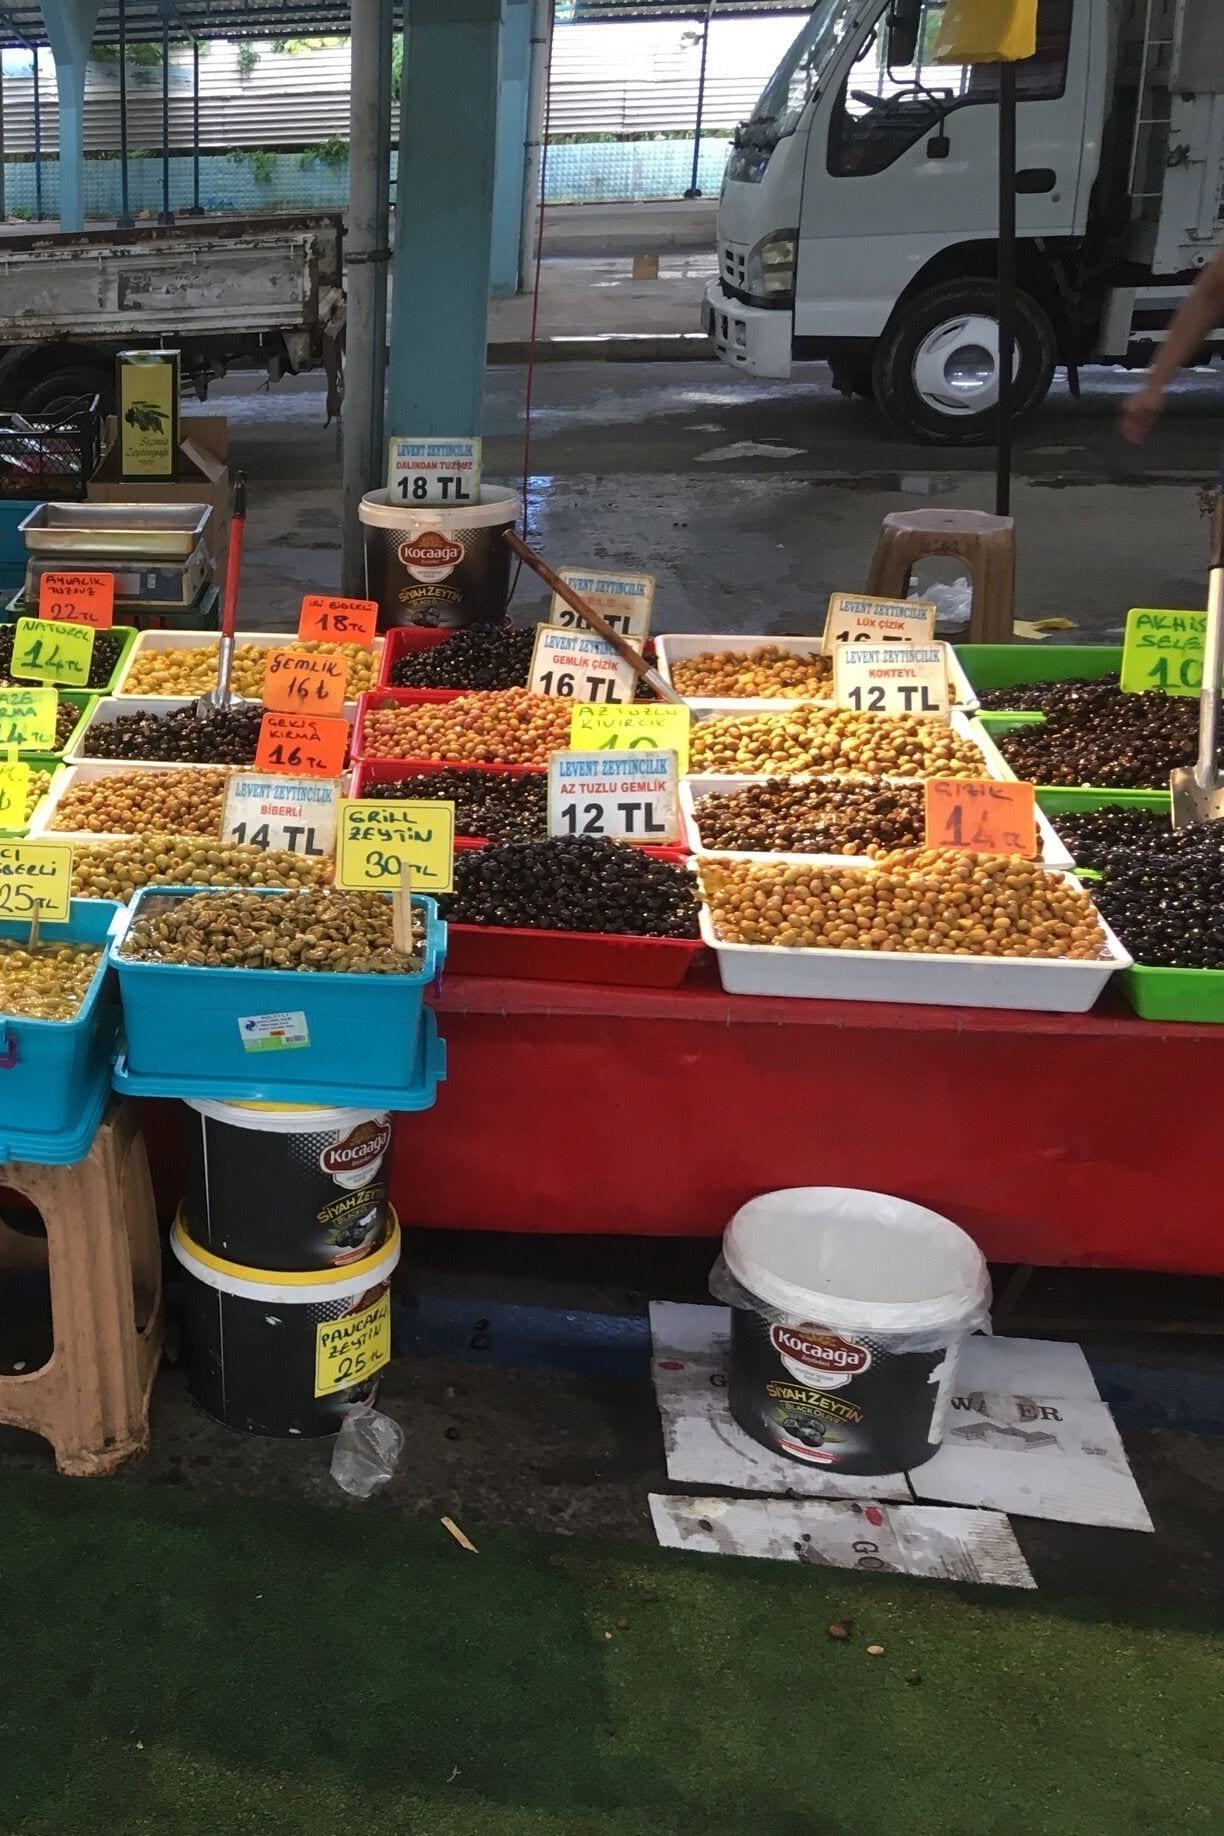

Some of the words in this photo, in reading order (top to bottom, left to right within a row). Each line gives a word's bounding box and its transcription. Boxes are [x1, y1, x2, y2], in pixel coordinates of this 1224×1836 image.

[397, 444, 425, 458] LEVENT
[396, 460, 438, 471] DALINDAN
[397, 476, 426, 500] 18
[437, 476, 471, 500] TL
[50, 603, 79, 620] 22
[79, 611, 99, 622] TL
[840, 599, 873, 614] LEVENT
[315, 613, 349, 632] 18
[348, 623, 367, 633] TL
[1137, 613, 1208, 634] AKHİS
[544, 633, 577, 651] LEVENT
[20, 640, 64, 668] 14
[553, 653, 590, 669] GEMLİK
[845, 650, 881, 664] LEVENT
[868, 668, 917, 679] KOKTEYL
[539, 670, 575, 698] 16
[586, 675, 624, 705] TL
[848, 685, 887, 712] 12
[897, 685, 940, 712] TL
[267, 743, 302, 767] 16
[306, 758, 328, 770] TL
[559, 759, 601, 777] LEVENT
[235, 782, 271, 799] LEVENT
[559, 782, 577, 795] AZ
[579, 781, 618, 795] TUZLU
[620, 780, 667, 795] GEMLİK
[260, 804, 303, 818] BİBERLİ
[560, 802, 605, 835] 12
[617, 801, 666, 833] TL
[231, 821, 271, 848] 14
[282, 825, 324, 856] TL
[364, 851, 402, 879] 30
[329, 1131, 388, 1164] Kocaağa
[778, 1329, 860, 1367] Kocaağa
[333, 1352, 366, 1384] 25
